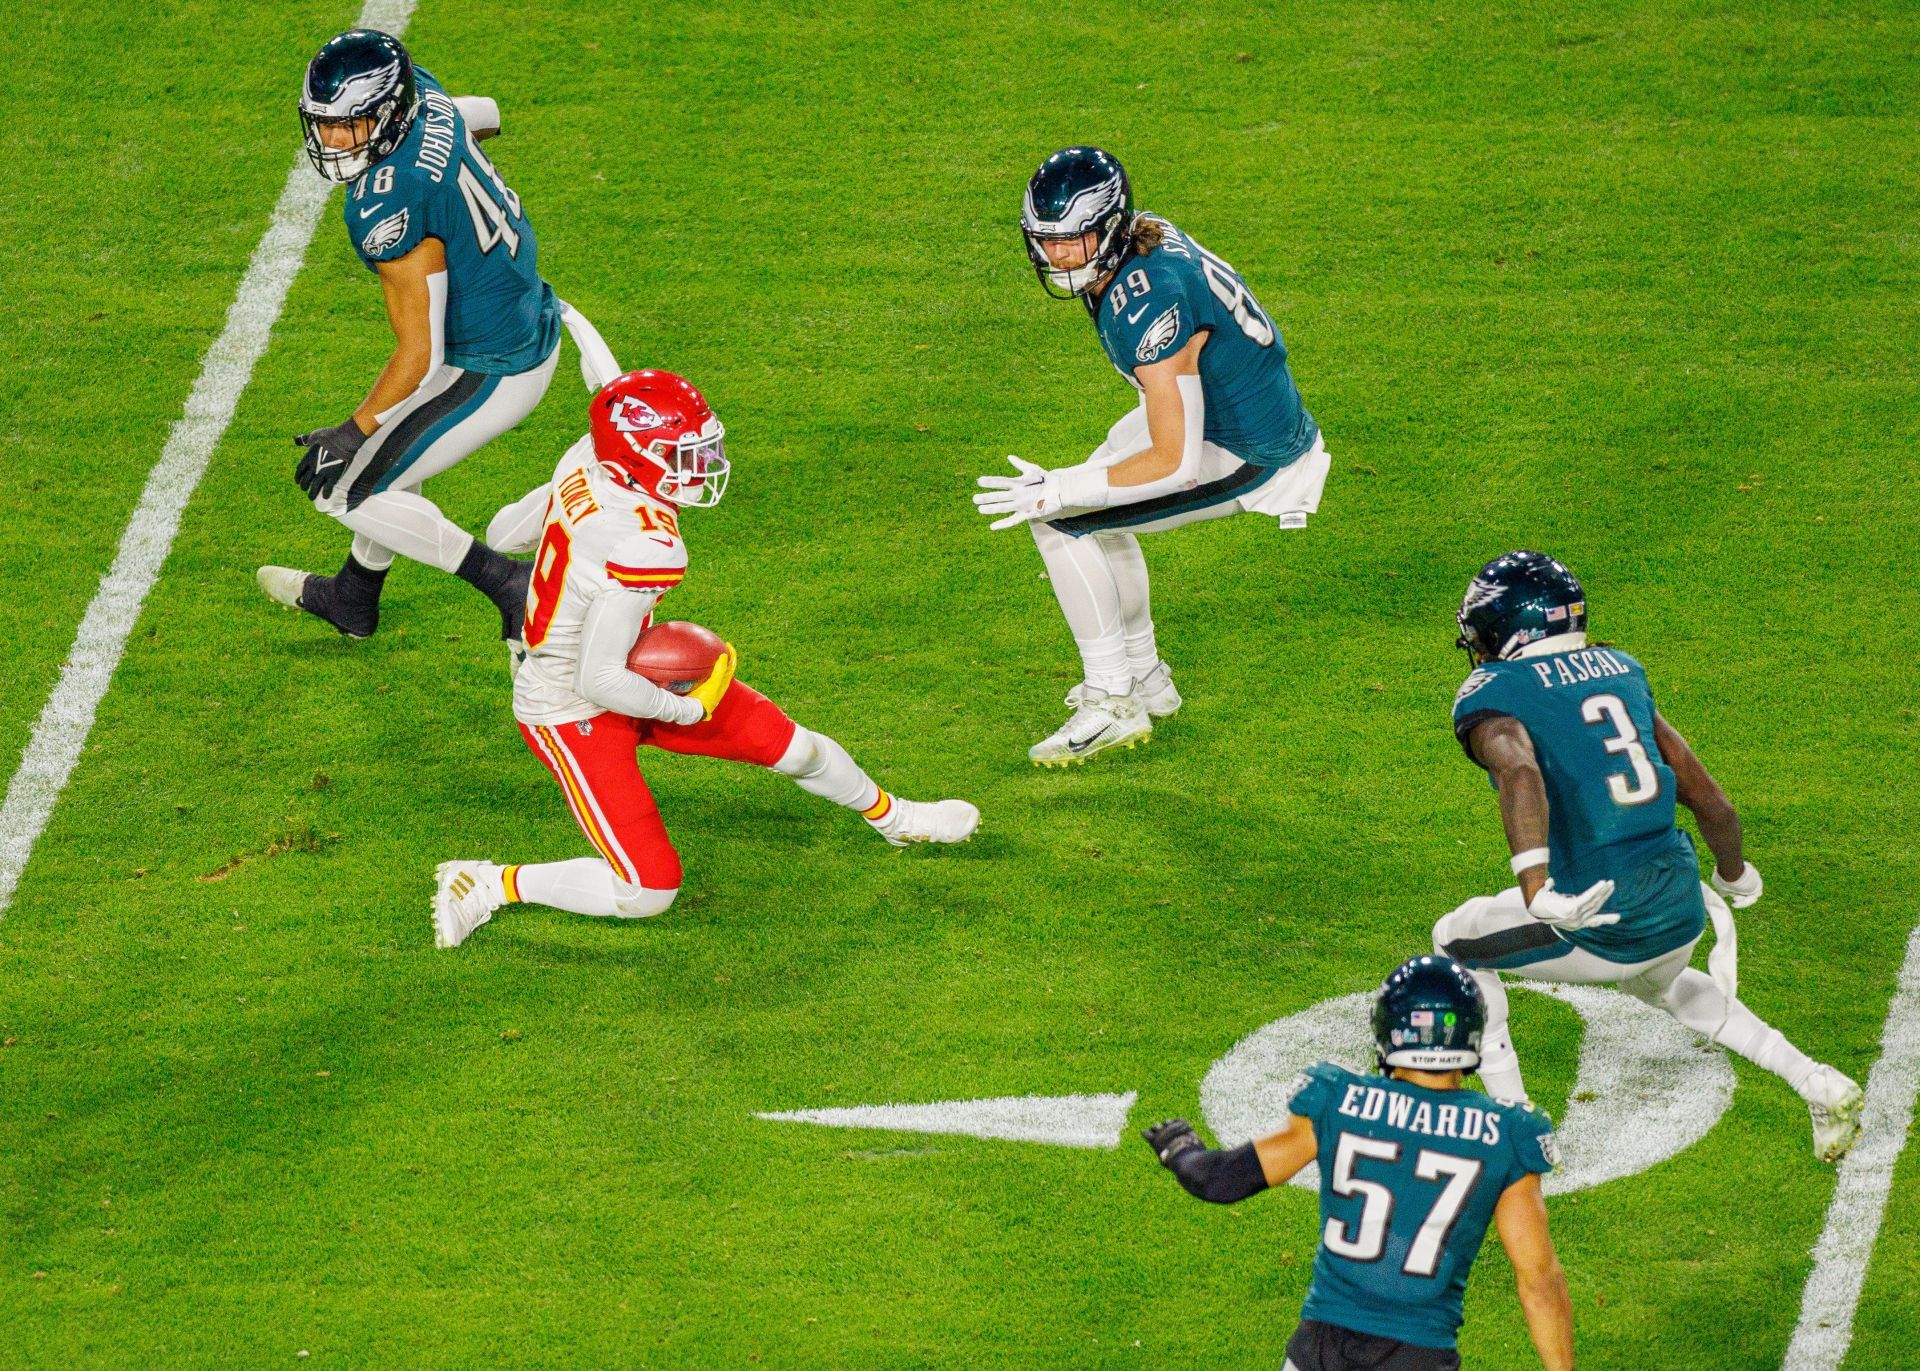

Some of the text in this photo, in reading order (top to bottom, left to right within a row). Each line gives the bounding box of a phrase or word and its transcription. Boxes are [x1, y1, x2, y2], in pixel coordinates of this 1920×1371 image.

[415, 88, 456, 184] JOHNSON
[352, 165, 396, 201] 48
[1109, 268, 1152, 317] 89
[619, 403, 656, 428] KC
[558, 467, 601, 526] TONEY
[633, 503, 681, 541] 19
[1531, 650, 1630, 689] PASCAL
[1580, 693, 1661, 807] 3
[1411, 1055, 1462, 1064] STOP HATE
[1338, 1083, 1501, 1146] EDWARDS
[1323, 1130, 1484, 1279] 57
